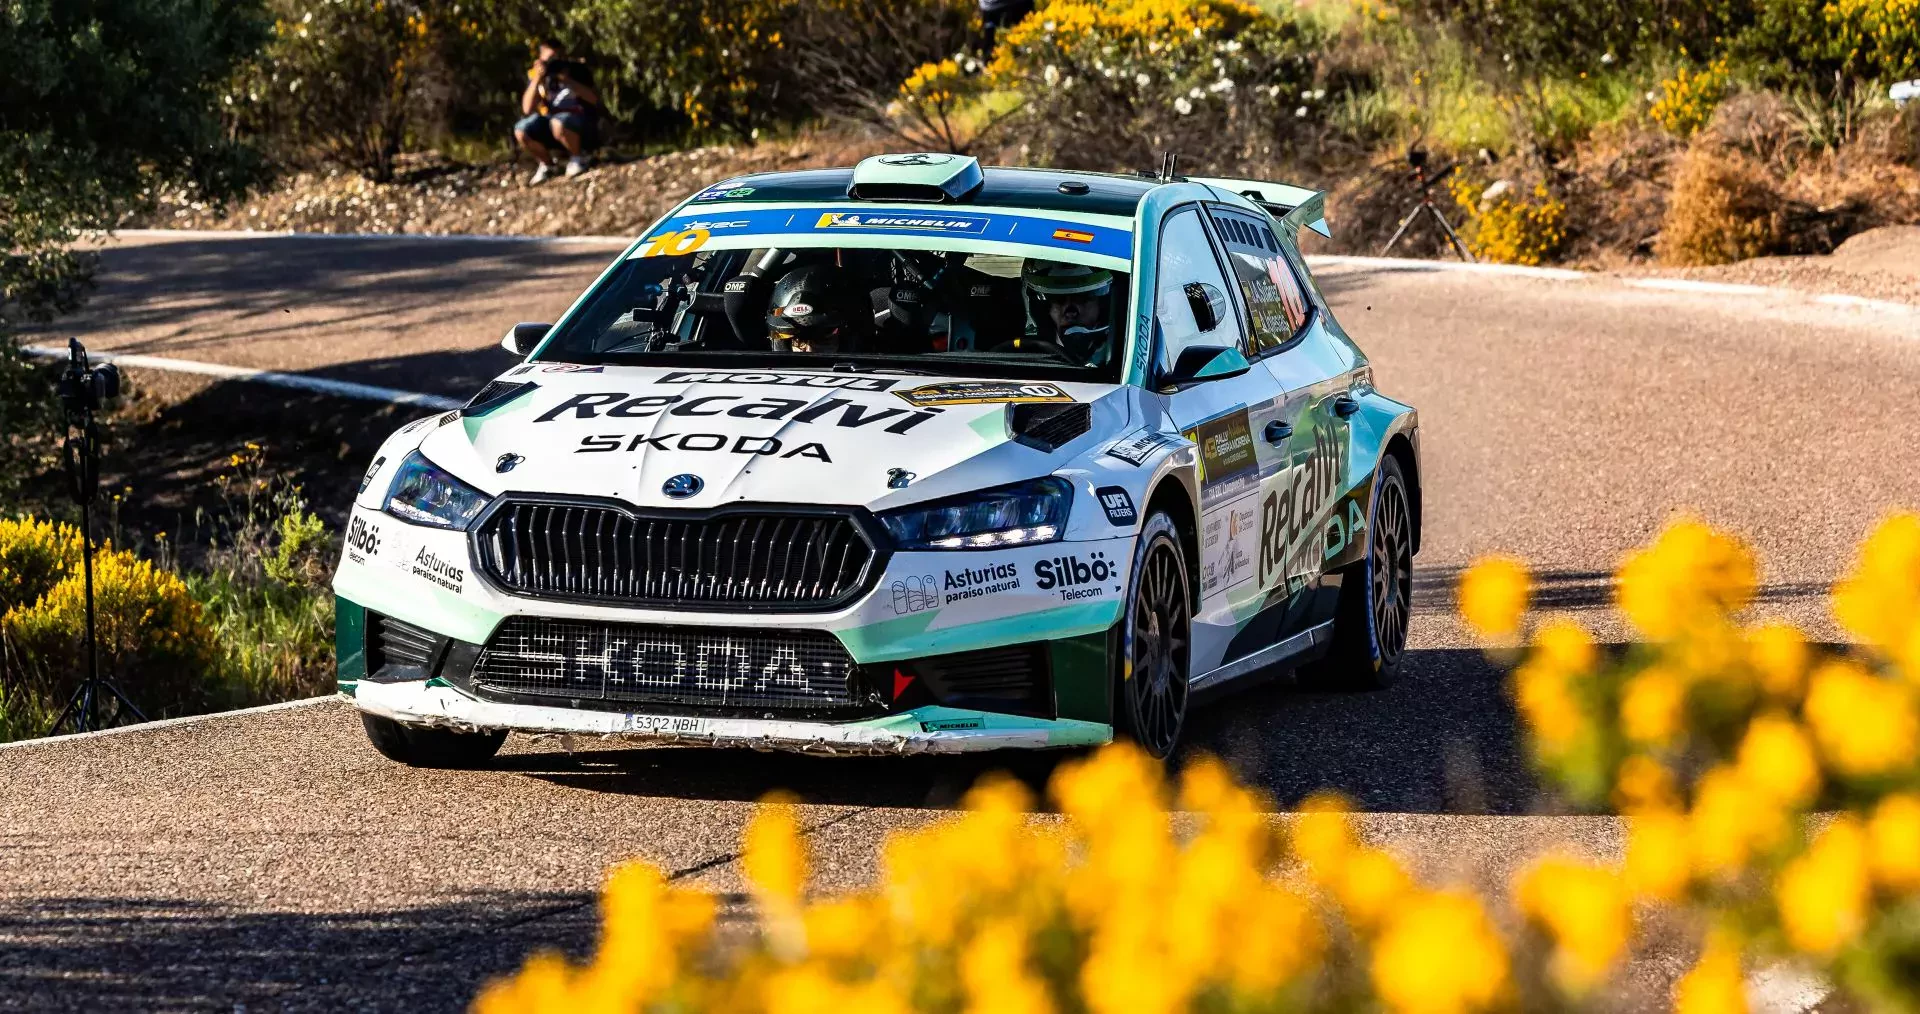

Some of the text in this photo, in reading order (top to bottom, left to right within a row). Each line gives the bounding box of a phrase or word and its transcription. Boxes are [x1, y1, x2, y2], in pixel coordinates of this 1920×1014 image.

[865, 217, 973, 228] MICHELIN
[643, 228, 712, 258] 10
[724, 282, 746, 292] OMP
[792, 305, 809, 313] BELL
[666, 372, 881, 391] MOTUL
[1029, 385, 1053, 396] 10
[533, 391, 946, 435] Recalvi
[573, 432, 834, 464] SKODA
[1101, 493, 1130, 509] UFI
[1258, 419, 1343, 591] Recalvi
[1108, 508, 1133, 519] FILTERS
[415, 545, 464, 583] Asturias
[412, 565, 463, 594] paraíso natural
[943, 562, 1017, 590] Asturias
[945, 577, 1021, 605] paraíso natural
[1059, 586, 1103, 601] Telecom
[518, 632, 814, 695] SKODA
[636, 716, 699, 733] 5302 NBH
[939, 722, 979, 731] MICHELIN
